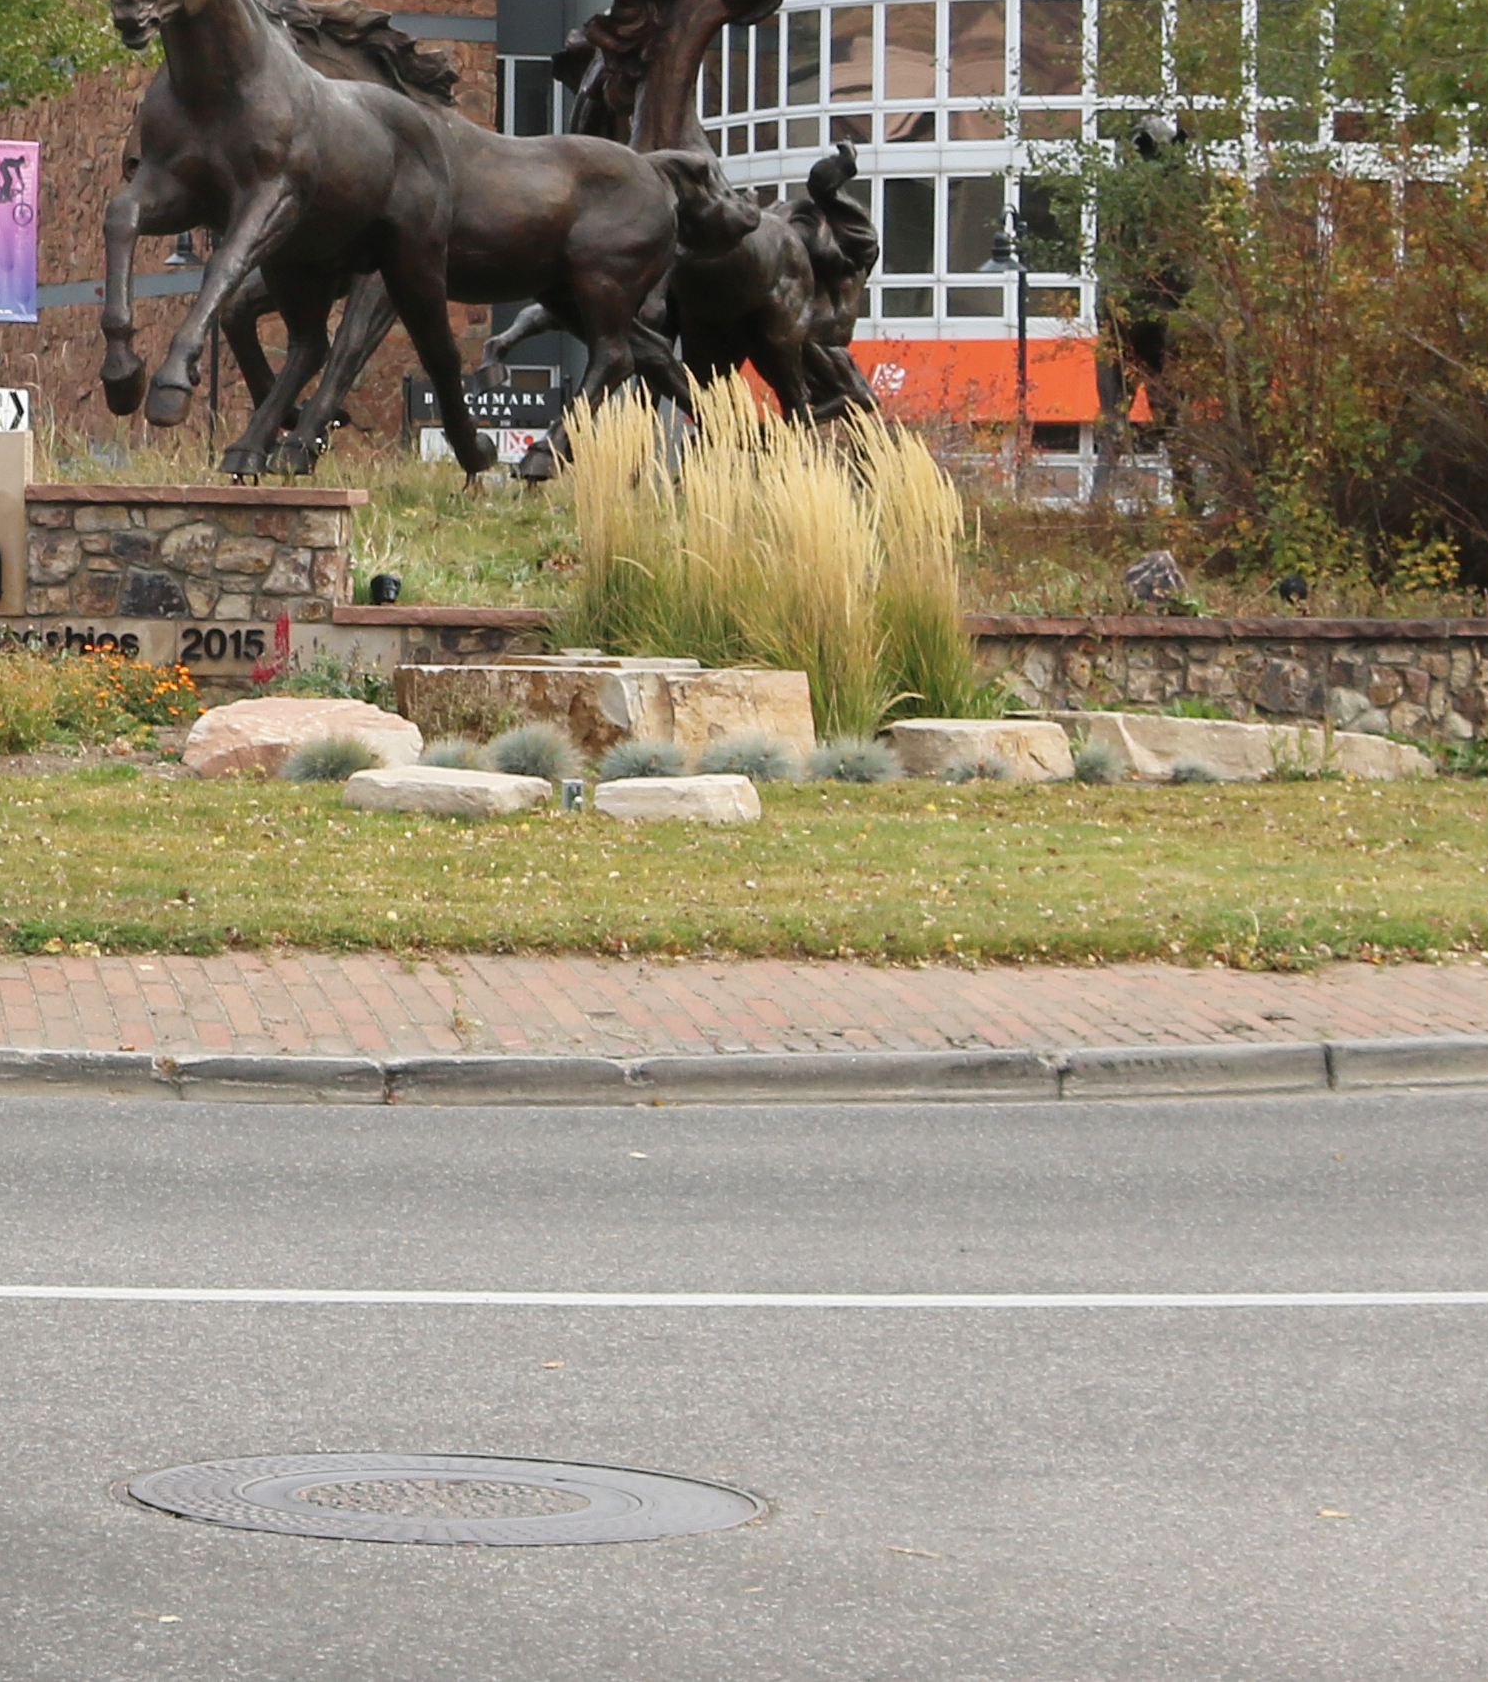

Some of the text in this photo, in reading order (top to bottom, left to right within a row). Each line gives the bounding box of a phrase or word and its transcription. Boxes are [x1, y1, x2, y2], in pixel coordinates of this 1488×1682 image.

[424, 391, 546, 406] BCHMARK
[468, 406, 512, 416] LAZA
[181, 628, 265, 660] 2015
